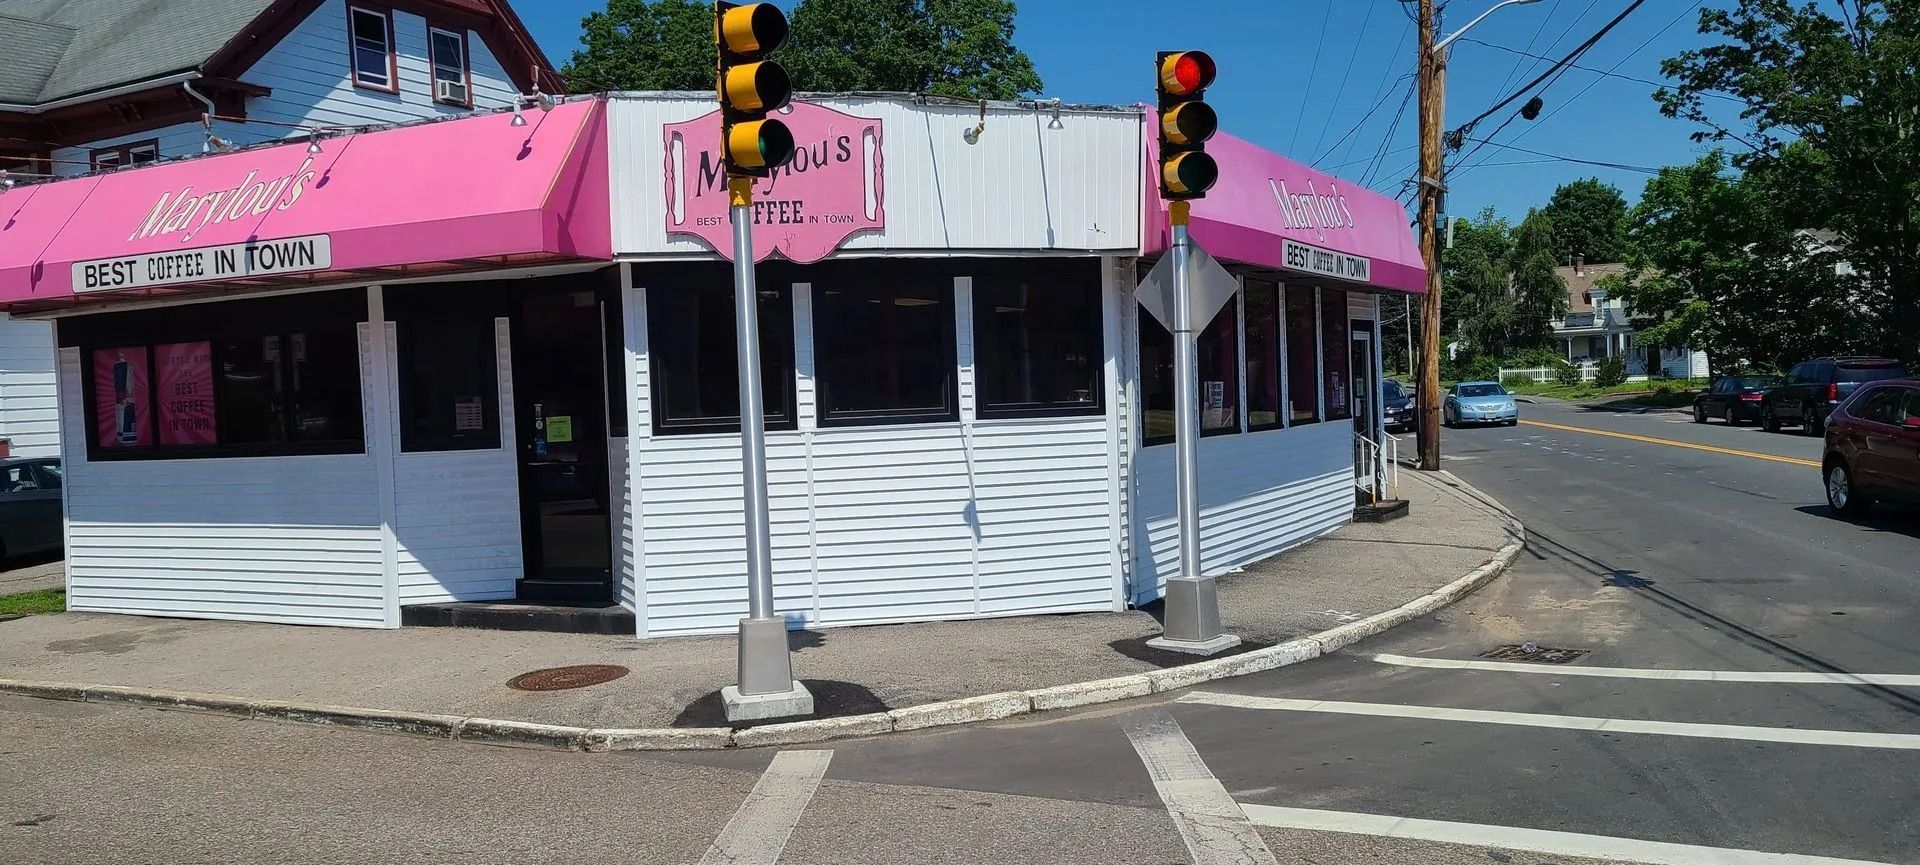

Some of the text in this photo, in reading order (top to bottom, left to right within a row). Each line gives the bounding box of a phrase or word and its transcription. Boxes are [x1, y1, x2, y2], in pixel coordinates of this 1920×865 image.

[127, 156, 317, 243] Marylou's
[697, 200, 854, 226] BEST FFEE IN TOWN
[1268, 178, 1354, 242] Marylou's
[84, 240, 315, 288] BEST COFFEE IN TOWN
[1287, 244, 1367, 278] BEST COFFEE IN TOWN
[175, 382, 198, 395] BEST
[170, 399, 206, 414] COFFEE
[168, 417, 209, 432] IN TOWN
